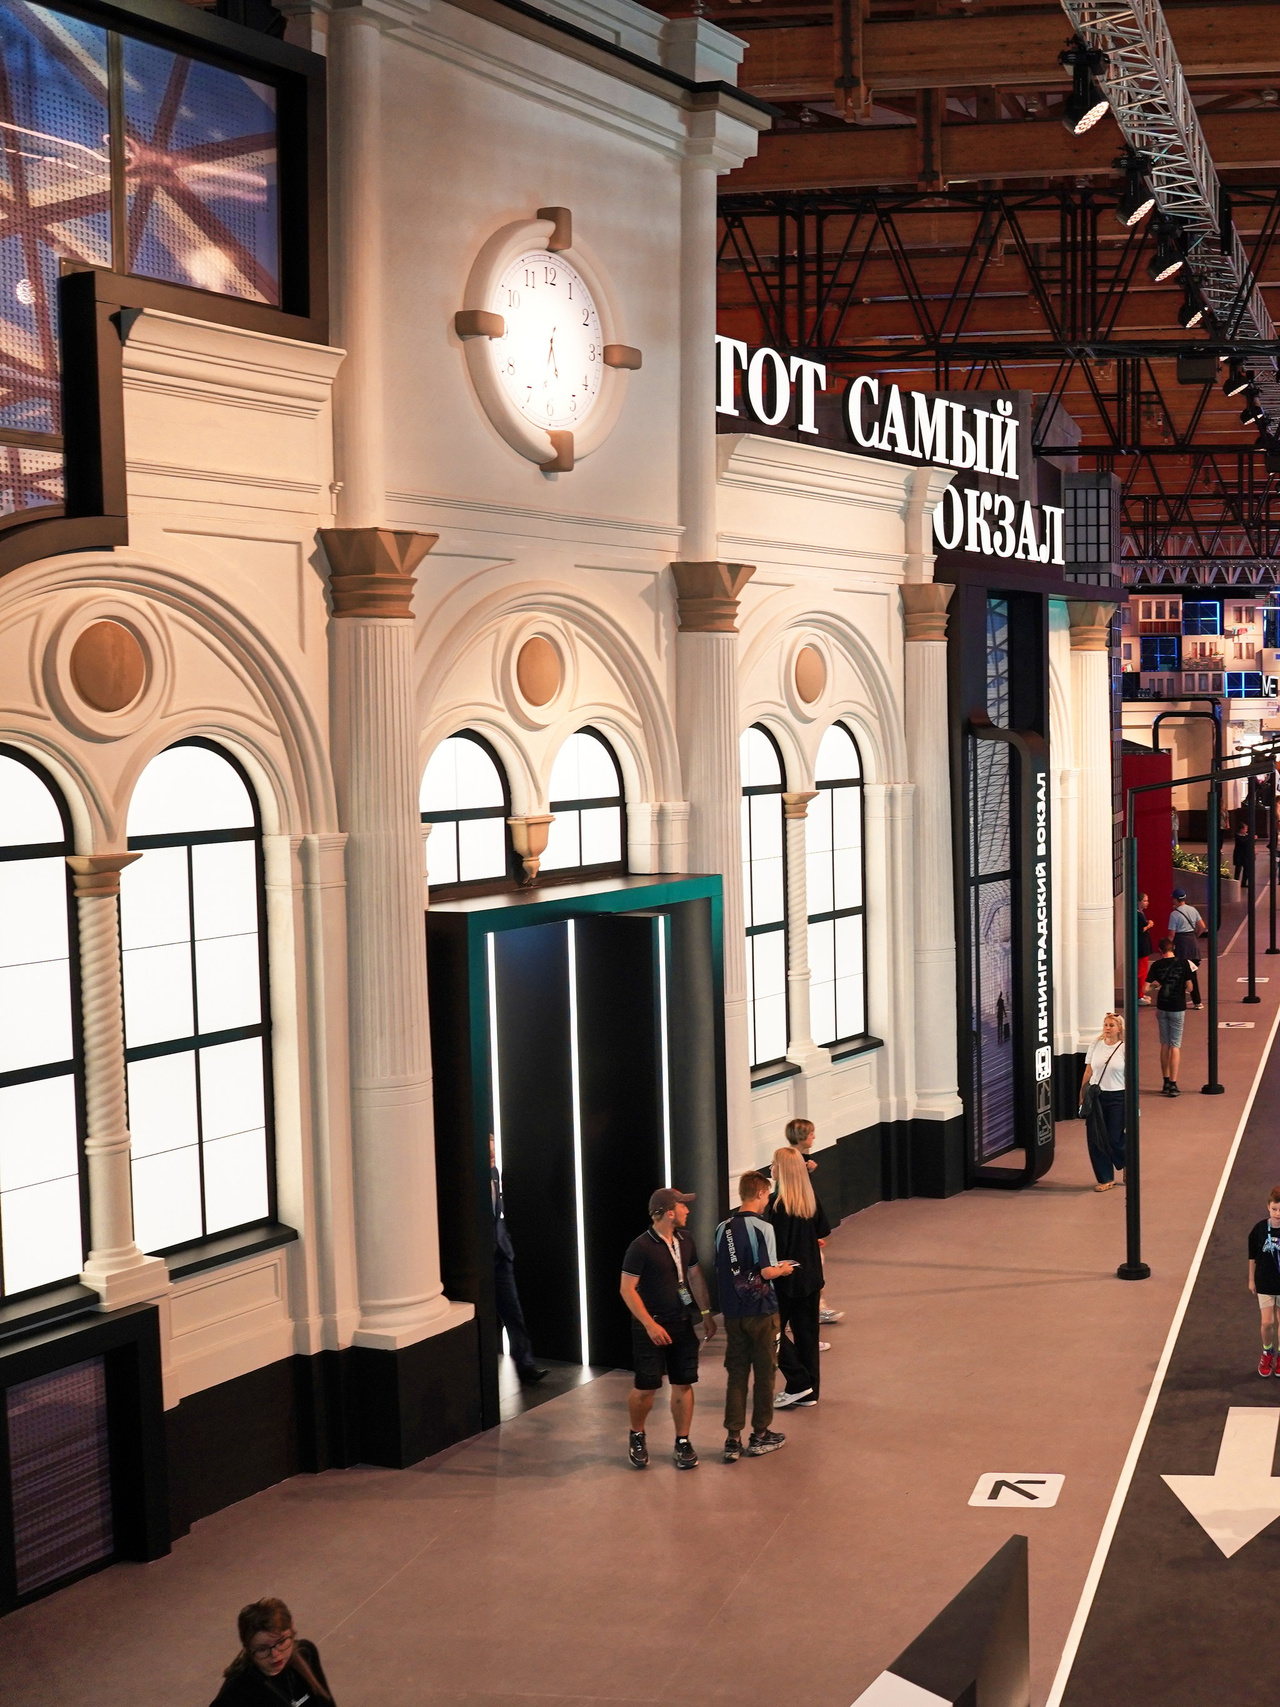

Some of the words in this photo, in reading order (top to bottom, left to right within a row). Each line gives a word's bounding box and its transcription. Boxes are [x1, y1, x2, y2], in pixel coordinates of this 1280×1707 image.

[525, 269, 535, 289] 11
[544, 266, 557, 286] 12
[508, 289, 520, 309] 10
[568, 282, 573, 300] 1
[582, 308, 589, 327] 2
[588, 343, 596, 361] 3
[507, 357, 515, 375] 8
[582, 374, 589, 391] 4
[848, 376, 1020, 480] САМЫЙ
[1037, 772, 1046, 856] ВОКЗАЛ
[1036, 862, 1048, 1043] ЛЕНИНГРАДСКИЙ
[725, 1229, 737, 1263] SUPREME
